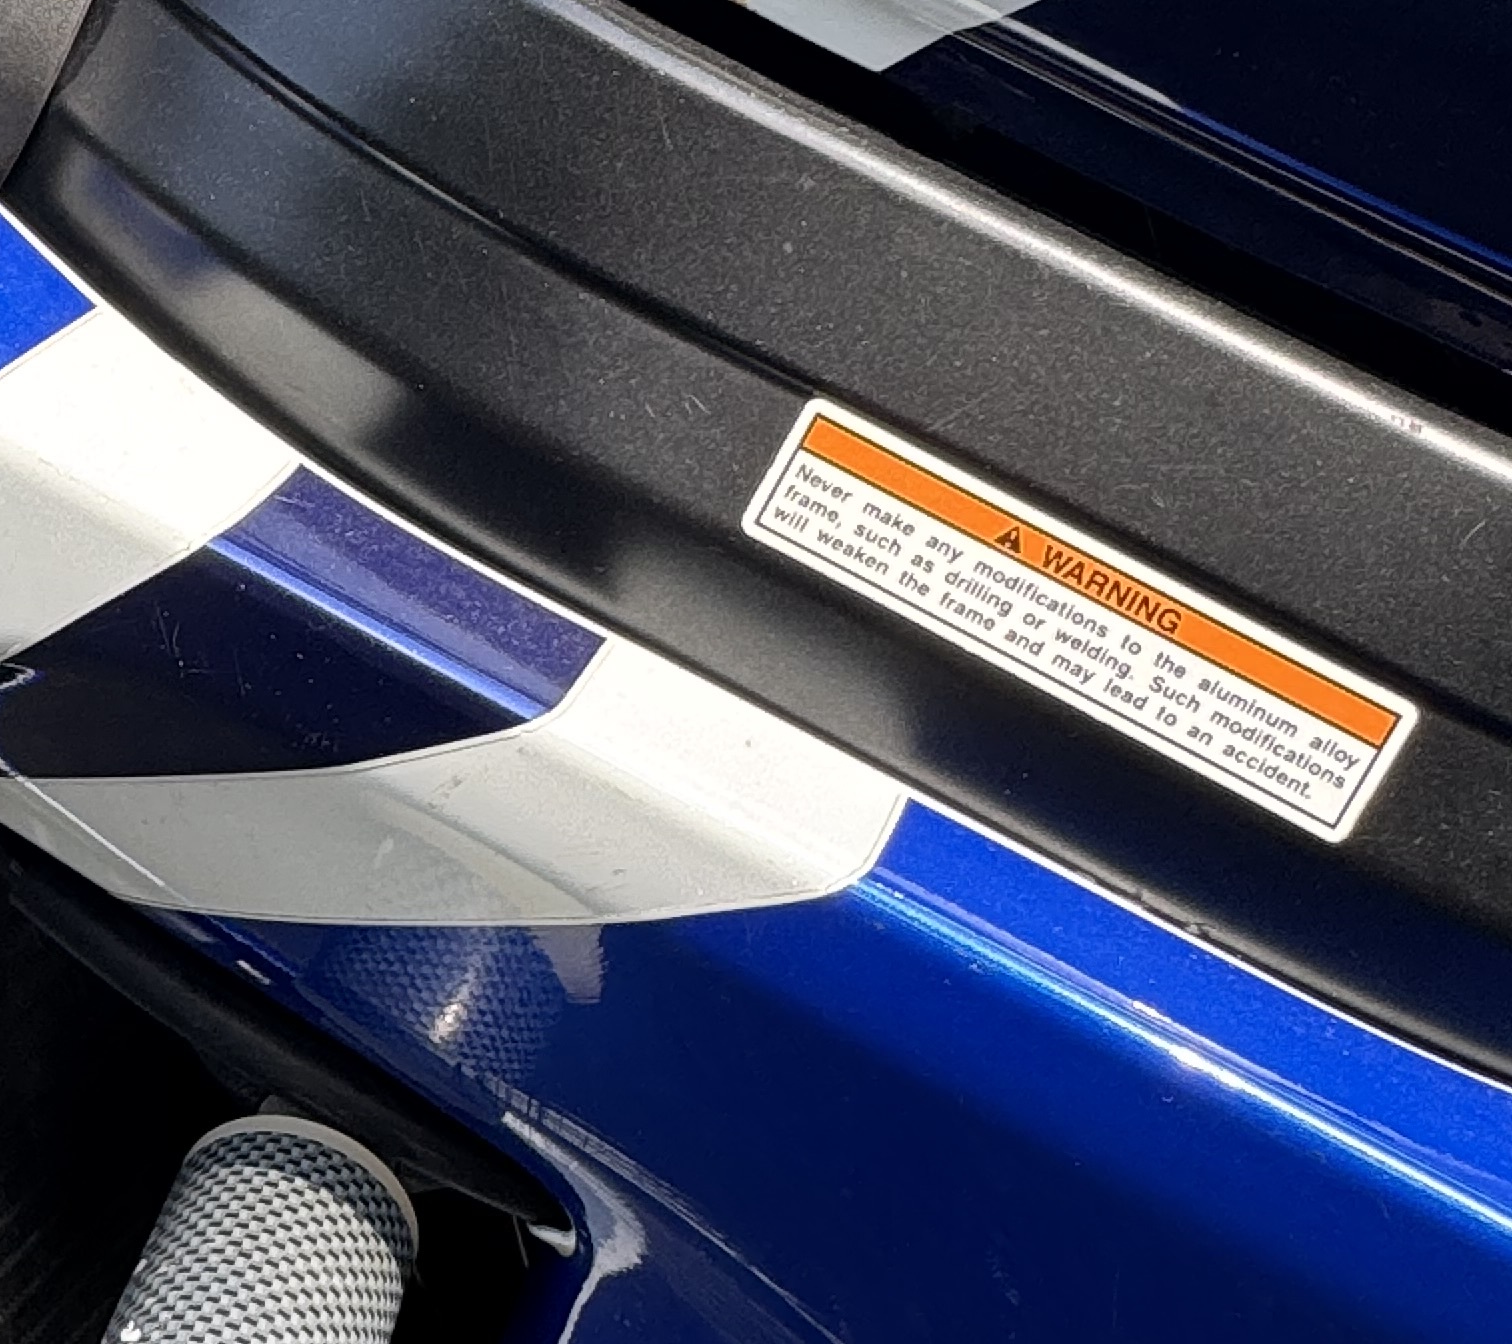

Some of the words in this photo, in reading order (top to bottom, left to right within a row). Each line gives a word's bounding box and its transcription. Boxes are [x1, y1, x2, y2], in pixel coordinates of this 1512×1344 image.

[773, 505, 810, 533] will
[816, 528, 889, 575] weaken
[897, 569, 930, 596] the
[938, 591, 996, 631] frame
[1003, 628, 1046, 656] and
[1050, 653, 1096, 685] may
[1102, 677, 1149, 711] lead
[1154, 705, 1178, 727] to
[1185, 724, 1214, 746] an
[1221, 743, 1310, 799] accident.
[783, 483, 841, 529] frame,
[852, 523, 902, 557] such
[909, 553, 935, 574] as
[943, 570, 1013, 618] drilling
[1021, 611, 1047, 630] or
[1054, 628, 1139, 680] welding.
[1147, 674, 1201, 713] Such
[1209, 710, 1345, 789] modifications
[794, 463, 853, 503] Never
[861, 501, 915, 536] make
[924, 535, 964, 564] any
[973, 560, 1108, 638] modifications
[1119, 633, 1142, 656] to
[1152, 650, 1186, 679] the
[1197, 677, 1298, 737] aluminum
[1308, 735, 1360, 771] alloy
[1042, 545, 1181, 633] WARNING
